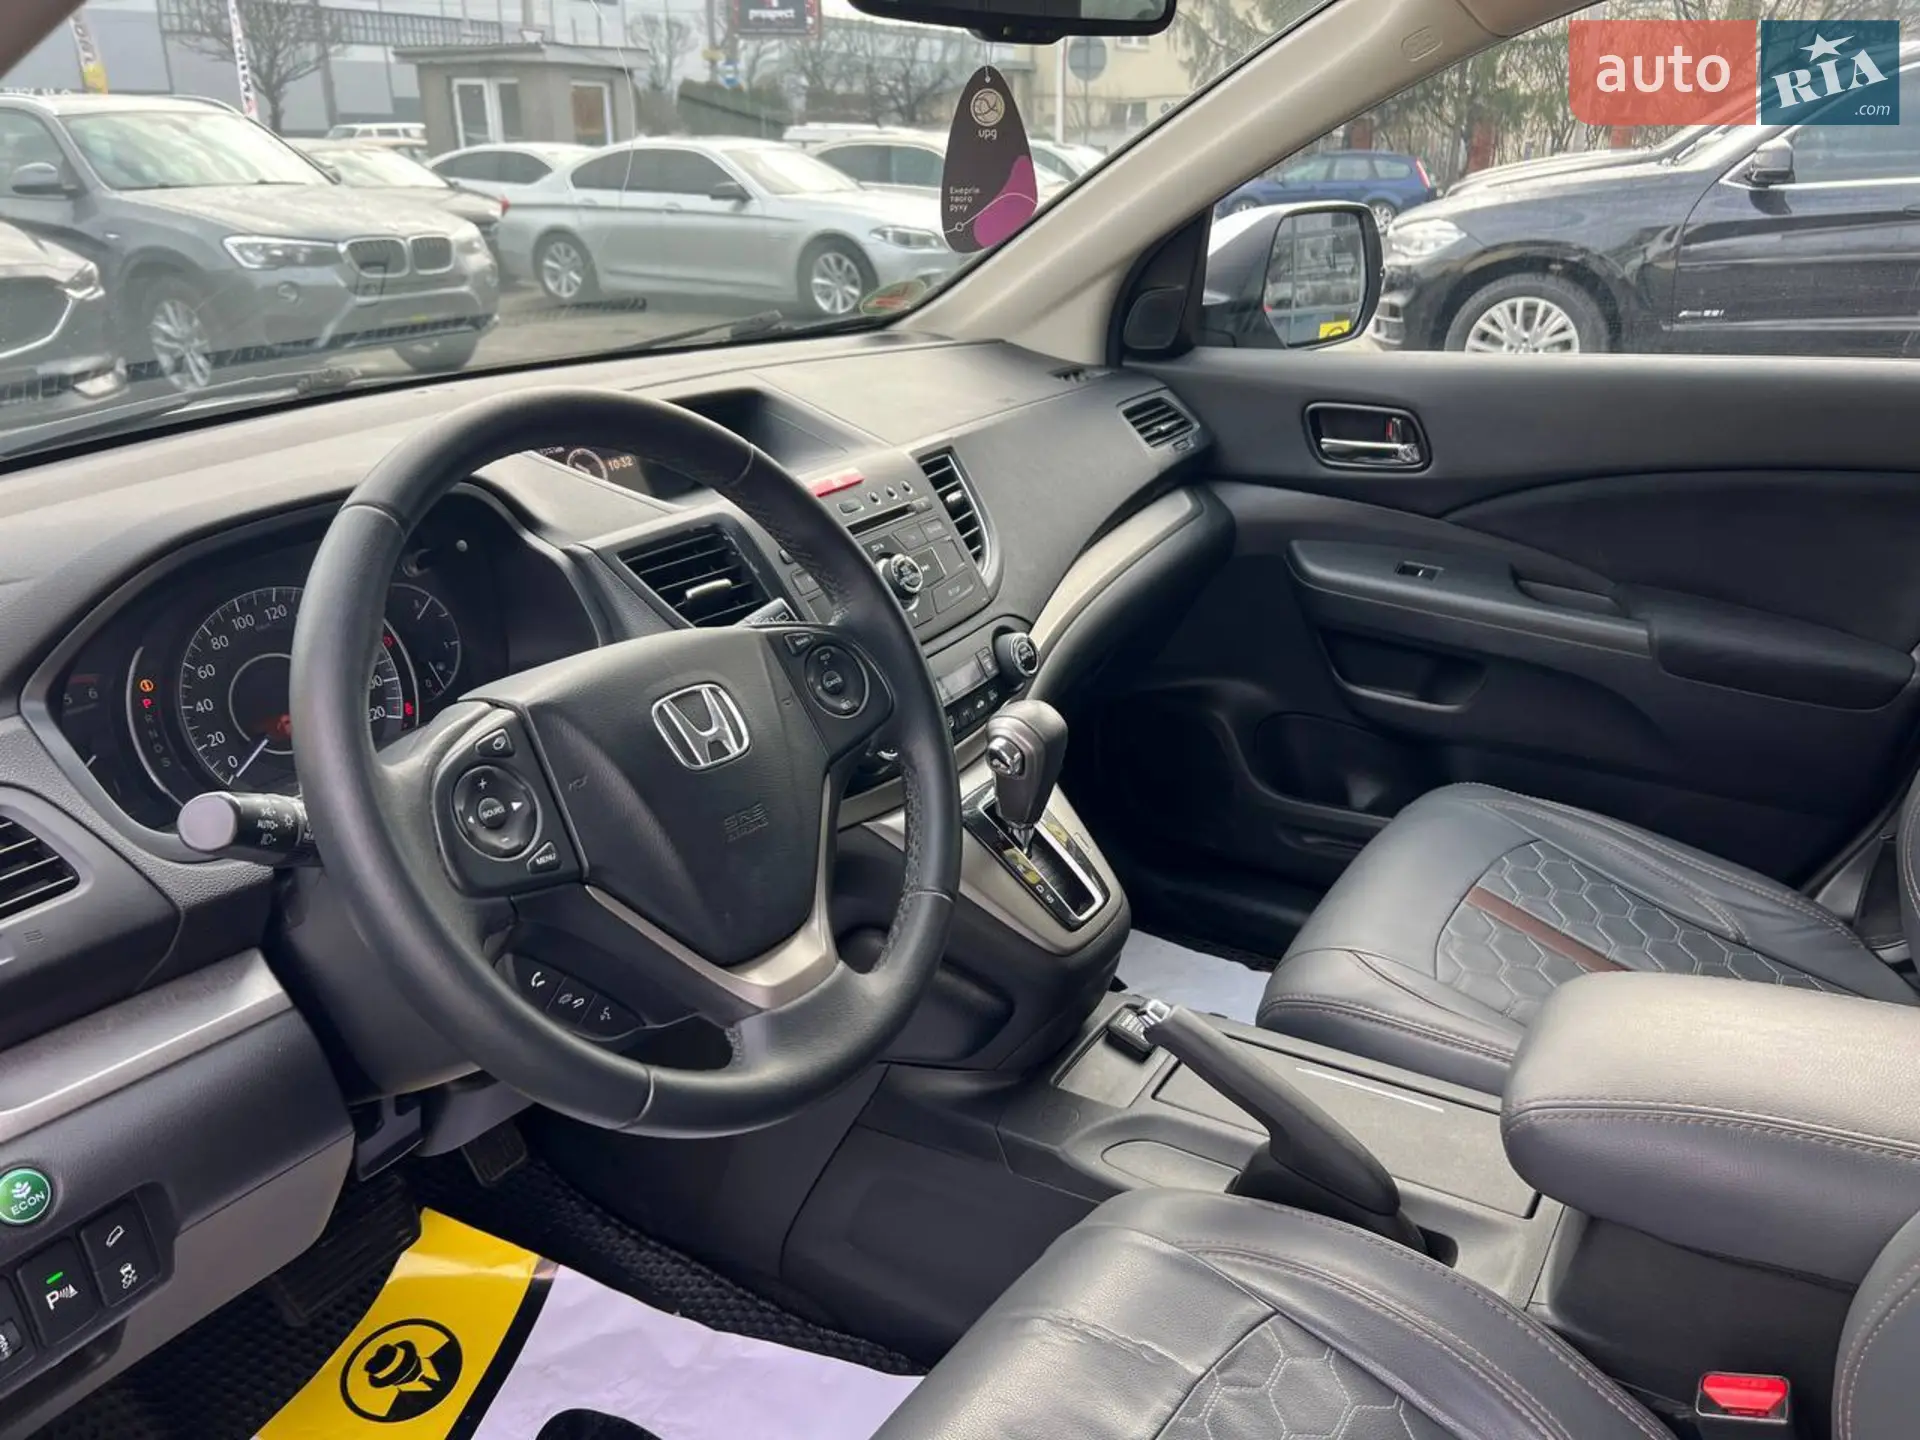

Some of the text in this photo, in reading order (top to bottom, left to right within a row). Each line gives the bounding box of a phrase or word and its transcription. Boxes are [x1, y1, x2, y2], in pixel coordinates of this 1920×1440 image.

[977, 128, 998, 140] upg
[949, 195, 973, 203] твого
[949, 203, 969, 213] руху
[264, 605, 288, 621] 120
[231, 614, 256, 631] 100
[210, 635, 230, 650] 80
[197, 663, 216, 679] 60
[195, 698, 214, 714] 40
[206, 731, 226, 747] 20
[227, 755, 238, 768] 0
[535, 853, 557, 865] MENU
[11, 1191, 46, 1216] ECON
